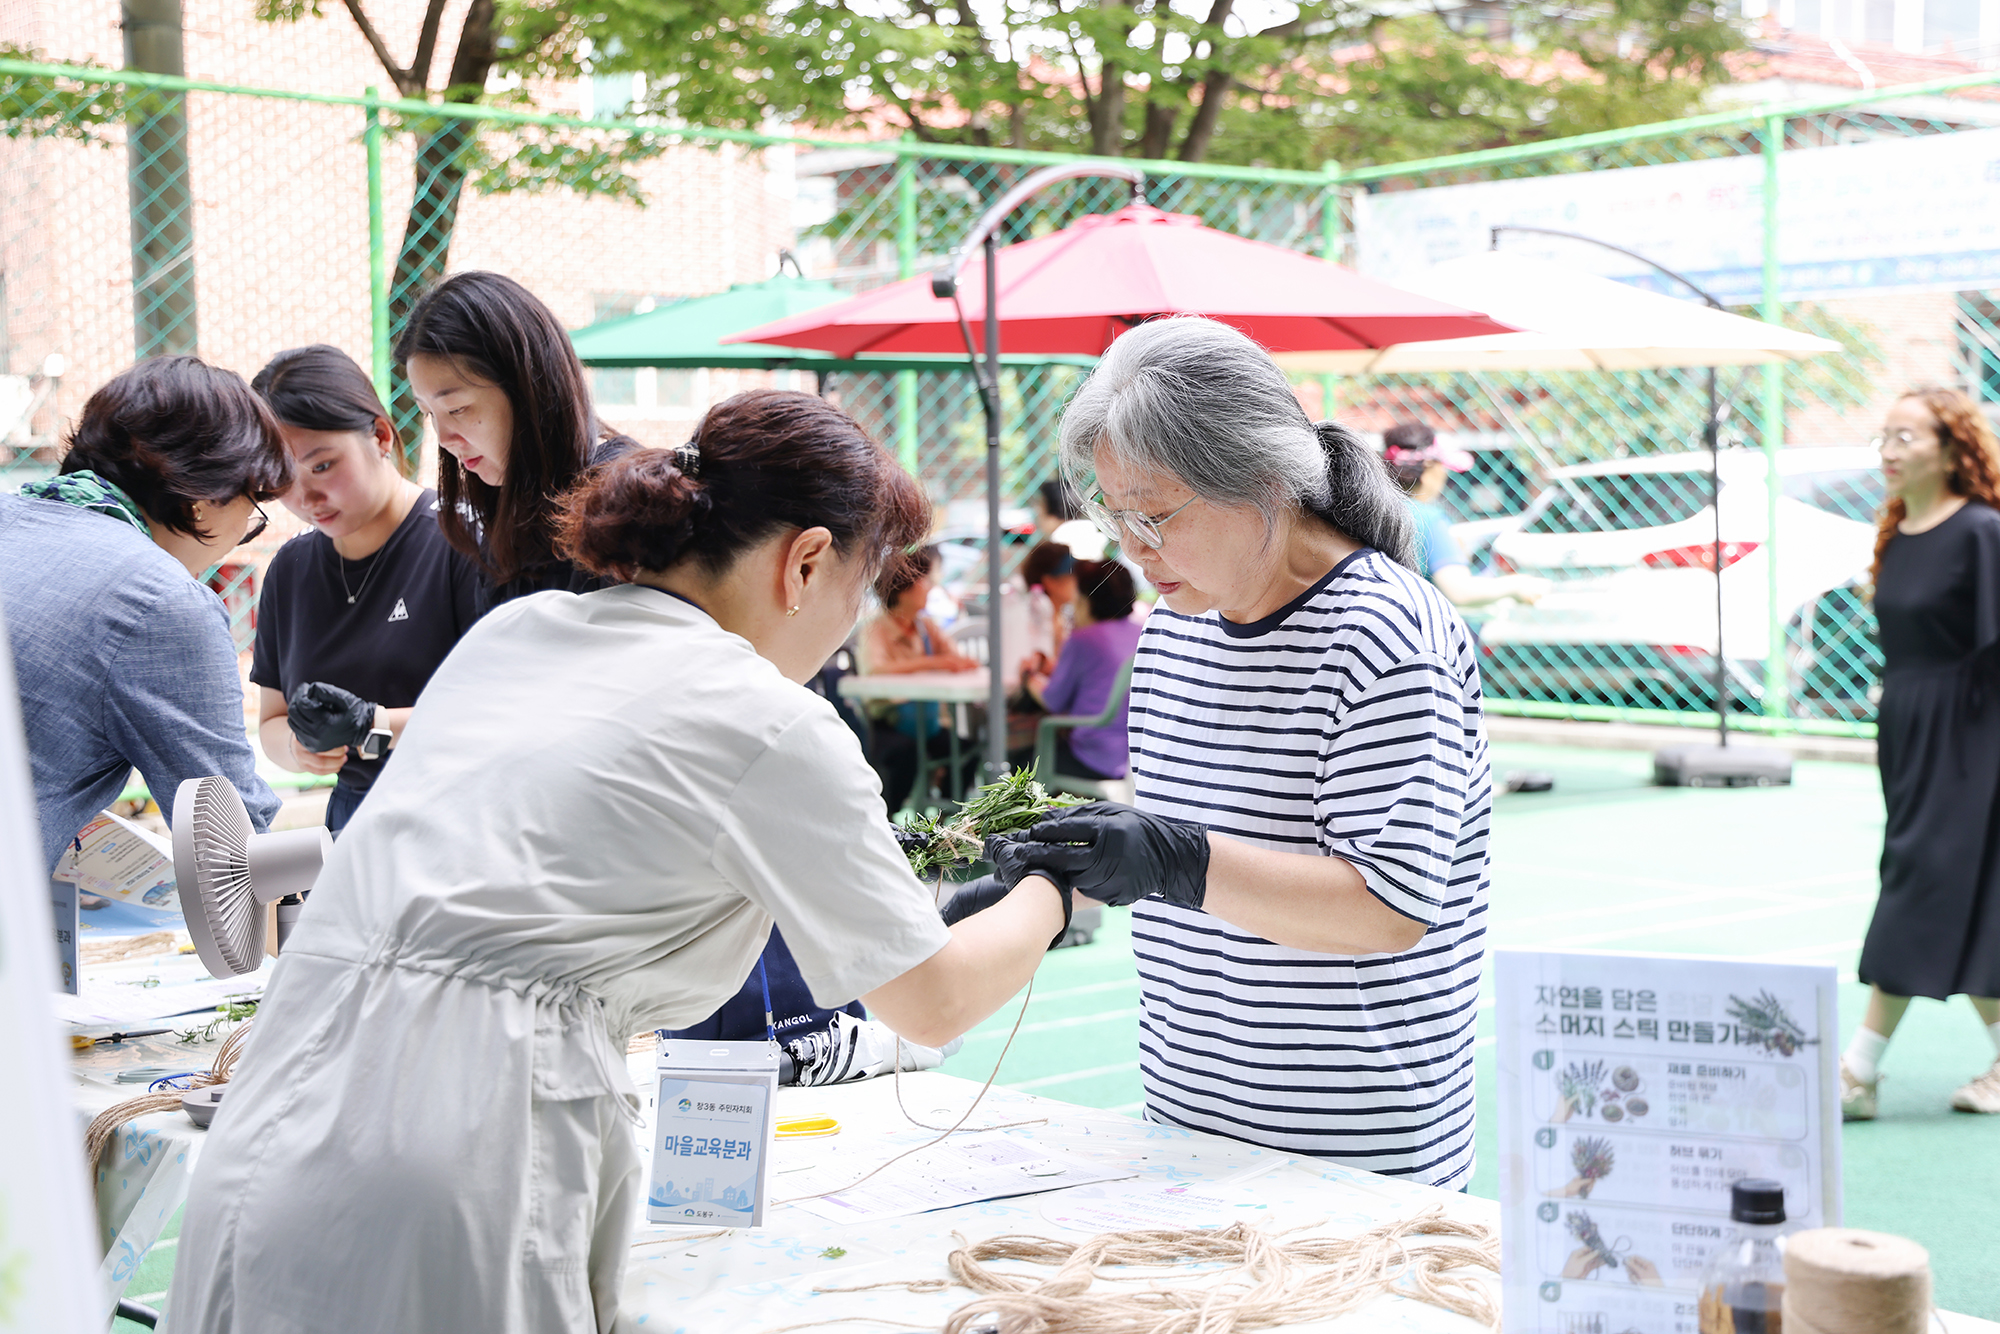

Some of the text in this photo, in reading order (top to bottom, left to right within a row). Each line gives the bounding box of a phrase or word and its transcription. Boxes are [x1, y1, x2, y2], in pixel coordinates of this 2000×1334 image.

[1535, 984, 1657, 1012] 자연을 담은
[772, 1013, 813, 1031] KANGOL
[1534, 1012, 1740, 1045] 스머지 스틱 만들기
[1696, 1064, 1746, 1080] 준비하기
[696, 1102, 753, 1114] 창3동 주민자치회
[664, 1135, 752, 1161] 마을교육분과
[1672, 1223, 1721, 1238] 단단하게
